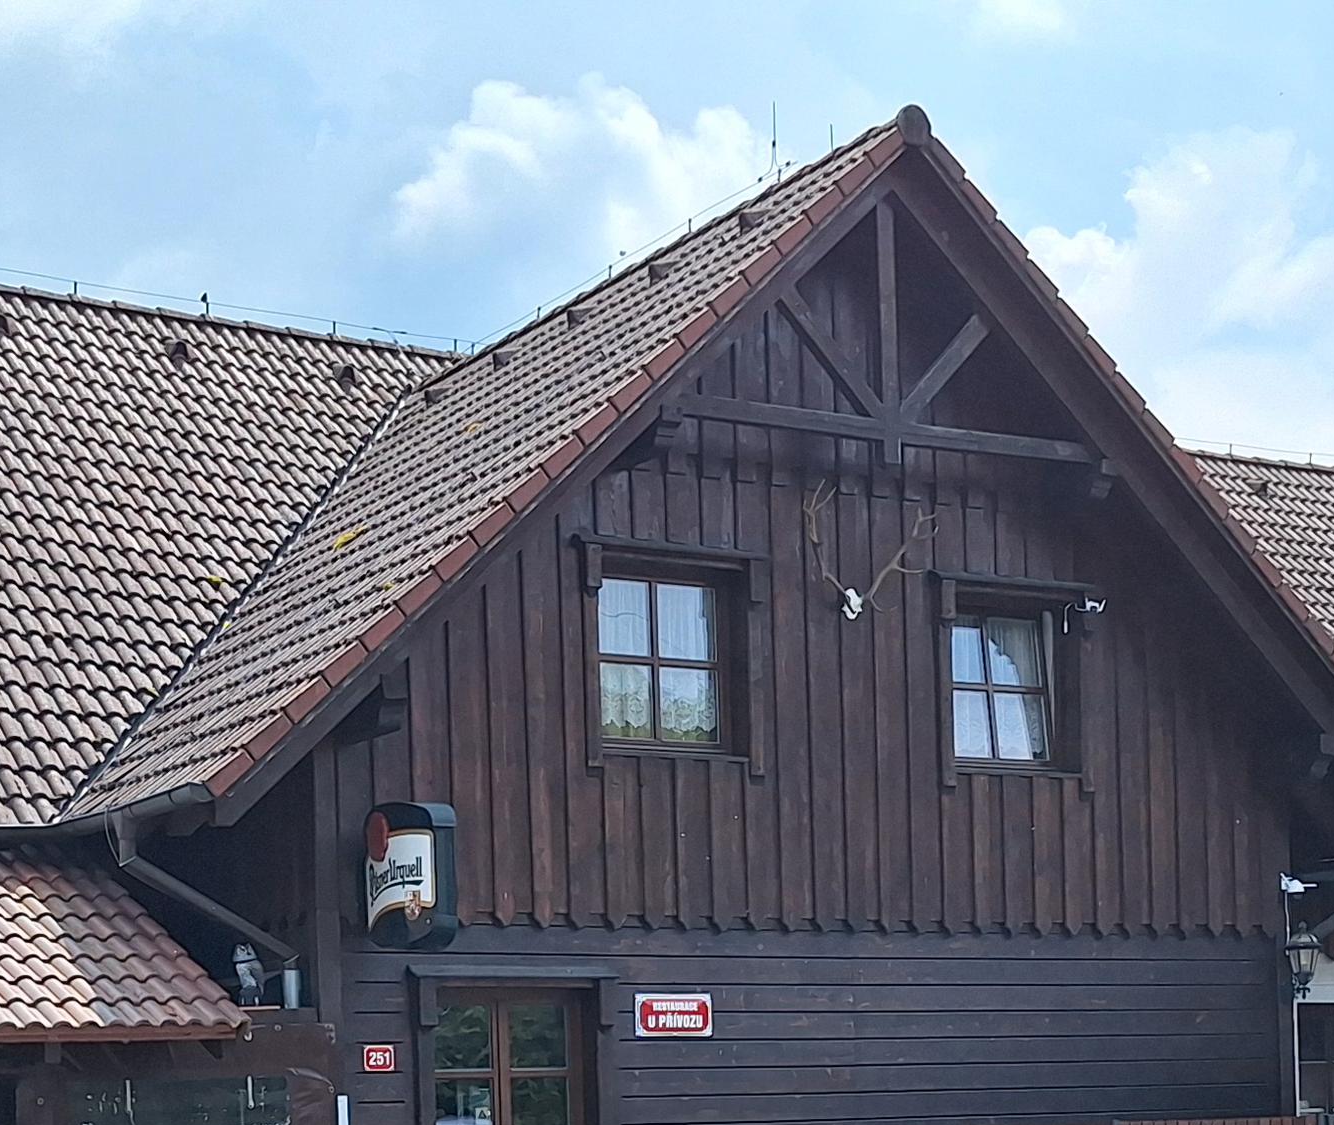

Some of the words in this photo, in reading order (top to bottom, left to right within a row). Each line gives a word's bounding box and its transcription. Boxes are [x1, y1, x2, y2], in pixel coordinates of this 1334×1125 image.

[369, 863, 391, 906] Pilsner
[388, 856, 423, 888] Urquell
[647, 1014, 656, 1028] U
[658, 1012, 703, 1028] PŘÍVOZU
[368, 1051, 391, 1066] 251
